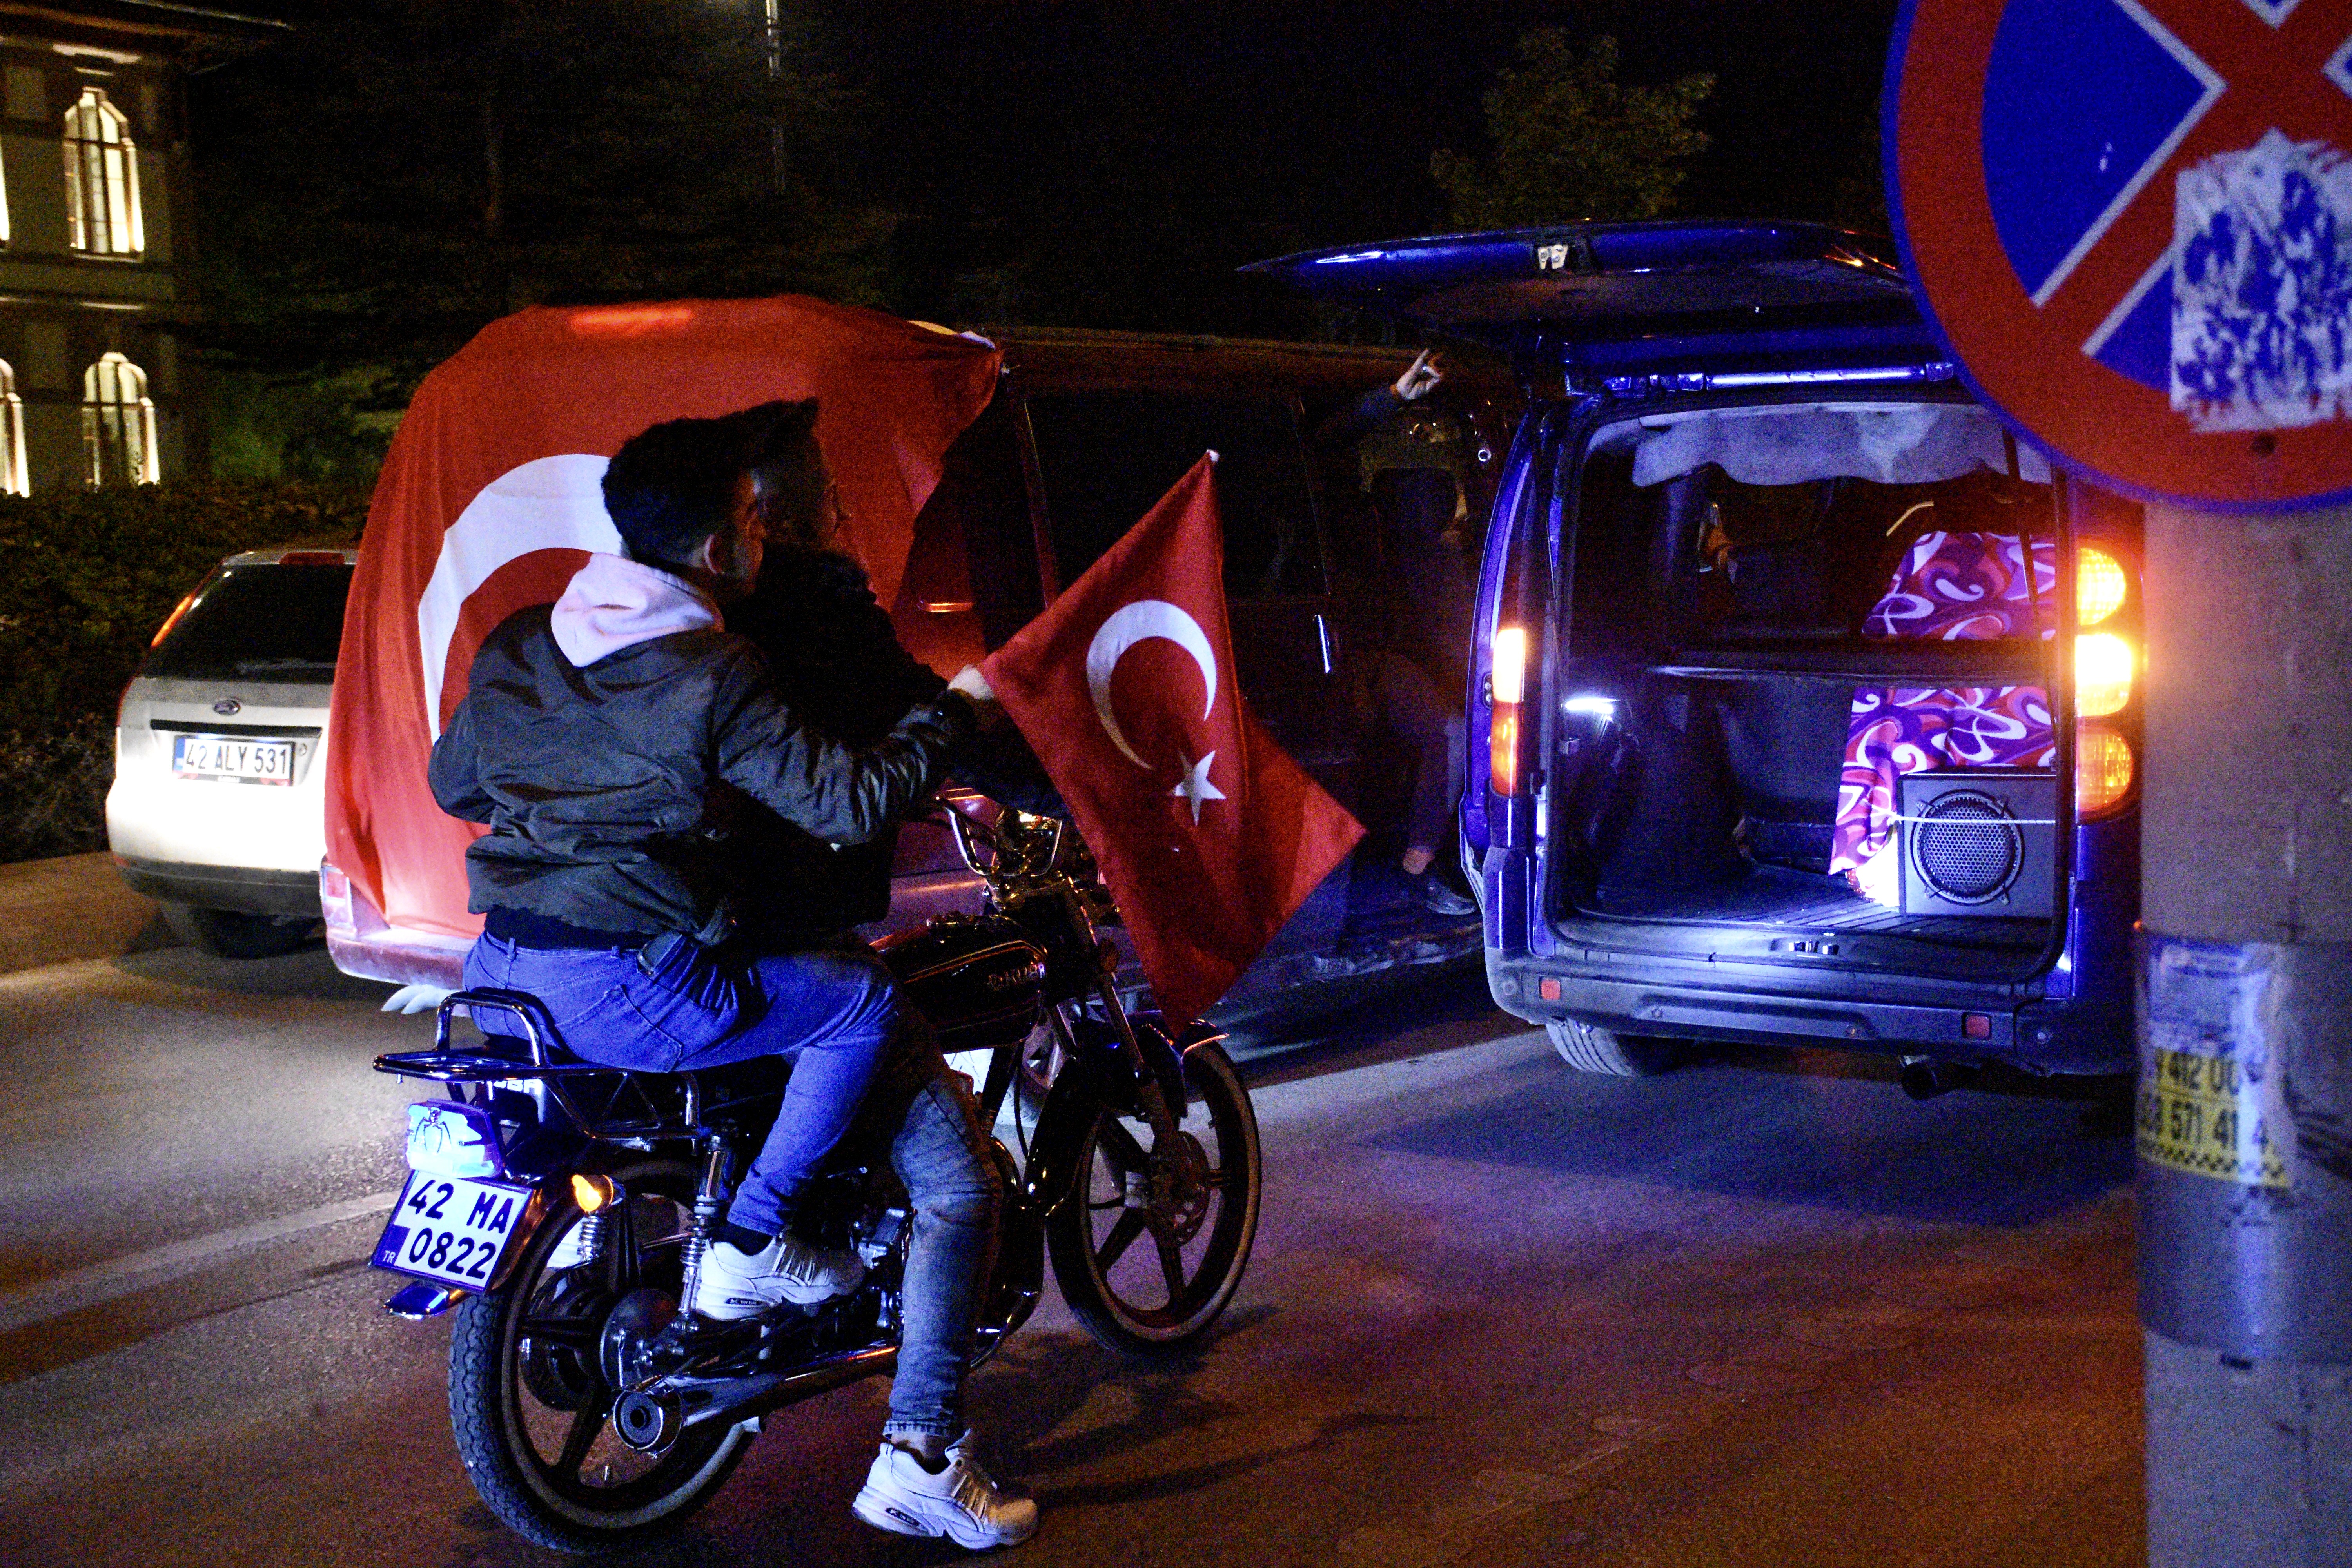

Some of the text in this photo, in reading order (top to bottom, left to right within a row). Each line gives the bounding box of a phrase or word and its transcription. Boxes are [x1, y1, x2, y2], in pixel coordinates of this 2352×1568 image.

[185, 744, 287, 775] 42 ALY 531
[408, 1180, 514, 1234] 42 MA
[383, 1250, 396, 1263] TR
[409, 1227, 496, 1280] 0822
